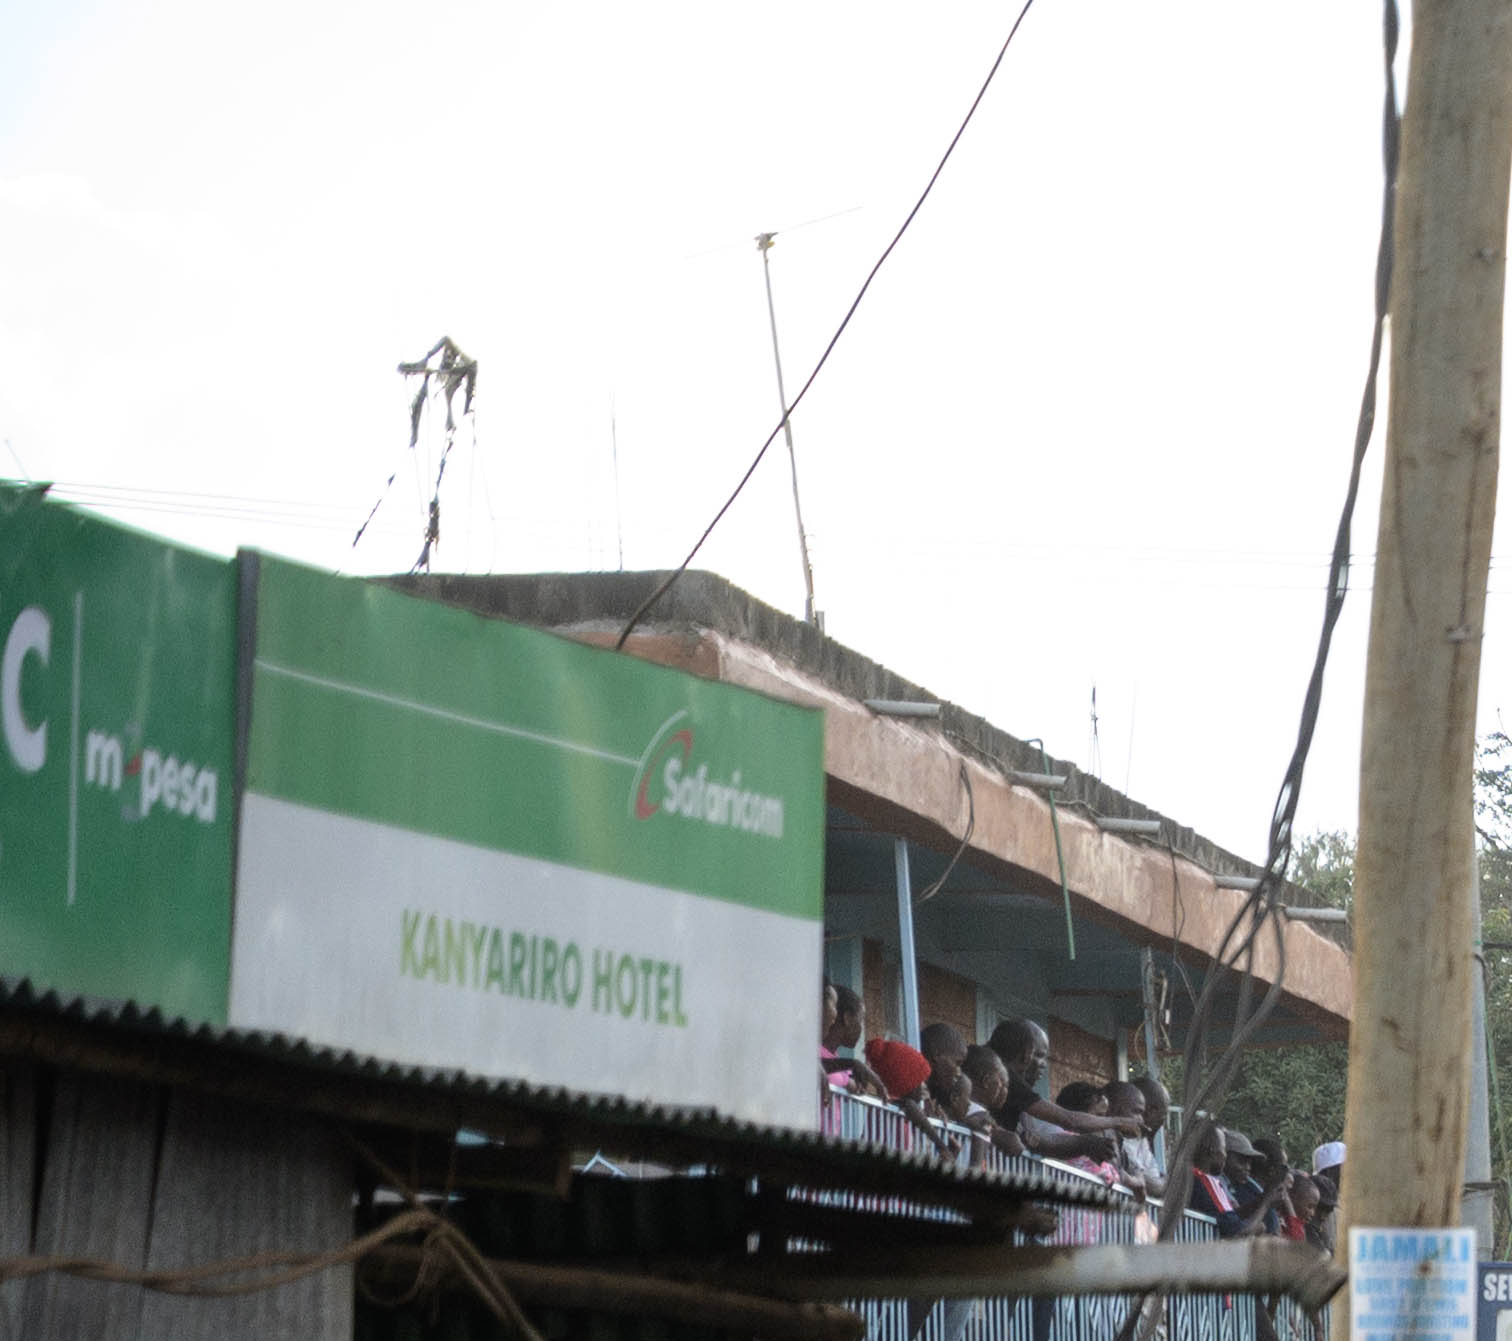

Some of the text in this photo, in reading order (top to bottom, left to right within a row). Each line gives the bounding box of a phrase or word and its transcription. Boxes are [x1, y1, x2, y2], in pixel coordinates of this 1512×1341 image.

[662, 758, 784, 840] Safaricom
[400, 908, 689, 1028] KANYARIRO HOTEL
